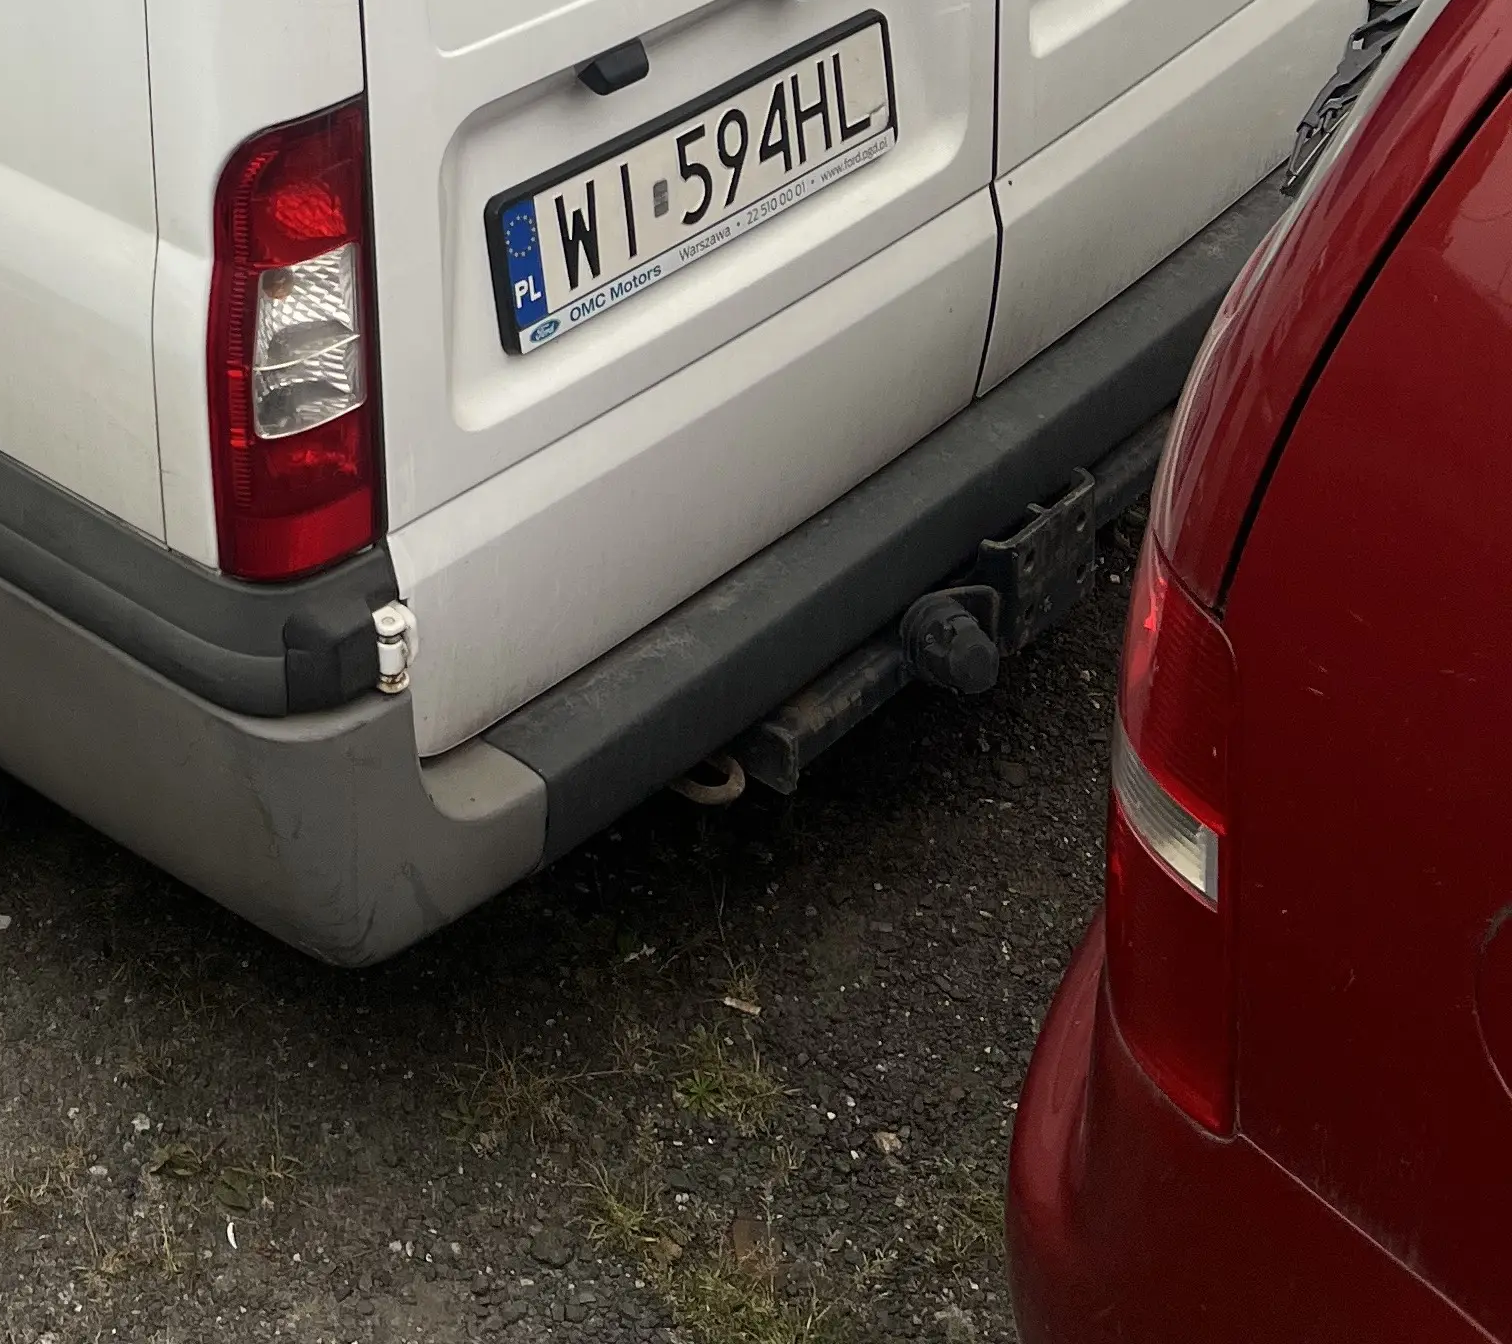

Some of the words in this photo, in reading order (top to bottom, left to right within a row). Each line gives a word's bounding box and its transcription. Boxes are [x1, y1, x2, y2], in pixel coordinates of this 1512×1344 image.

[554, 162, 638, 291] WI
[675, 51, 872, 225] 594HL
[569, 293, 607, 322] OMC
[610, 264, 662, 301] Motors
[679, 225, 732, 262] Warszawa
[746, 207, 760, 225] 22
[761, 199, 778, 219] 510
[779, 189, 793, 208] 00
[795, 181, 806, 198] 01
[819, 138, 889, 184] www.ford.pgd.pl
[514, 275, 542, 309] PL
